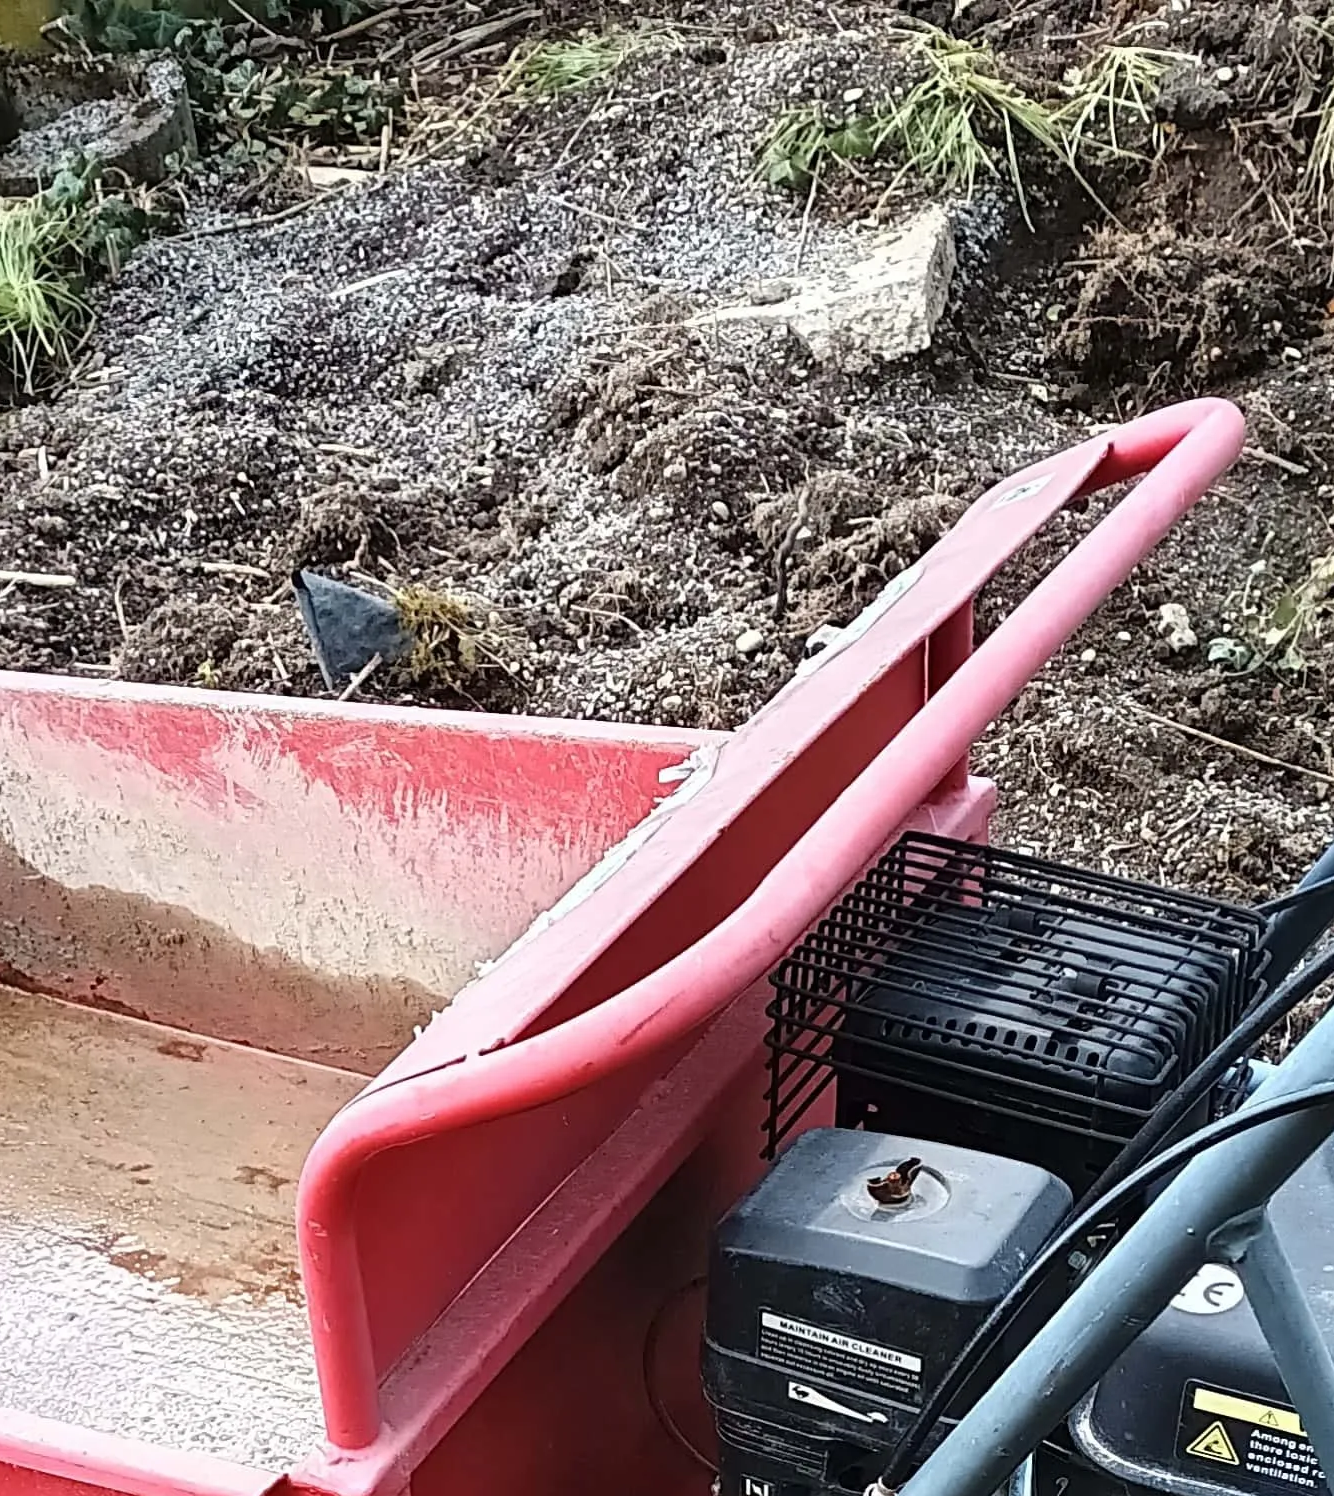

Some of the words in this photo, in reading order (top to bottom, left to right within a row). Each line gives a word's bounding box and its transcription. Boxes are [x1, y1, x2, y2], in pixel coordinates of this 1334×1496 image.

[779, 1320, 830, 1342] MAINTAIN
[831, 1336, 850, 1348] AIR
[851, 1343, 903, 1363] CLEANER
[1250, 1429, 1297, 1450] Among
[1247, 1452, 1310, 1475] enclosed
[1249, 1440, 1284, 1456] there
[1285, 1449, 1320, 1465] toxic
[1245, 1462, 1319, 1489] ventilation.
